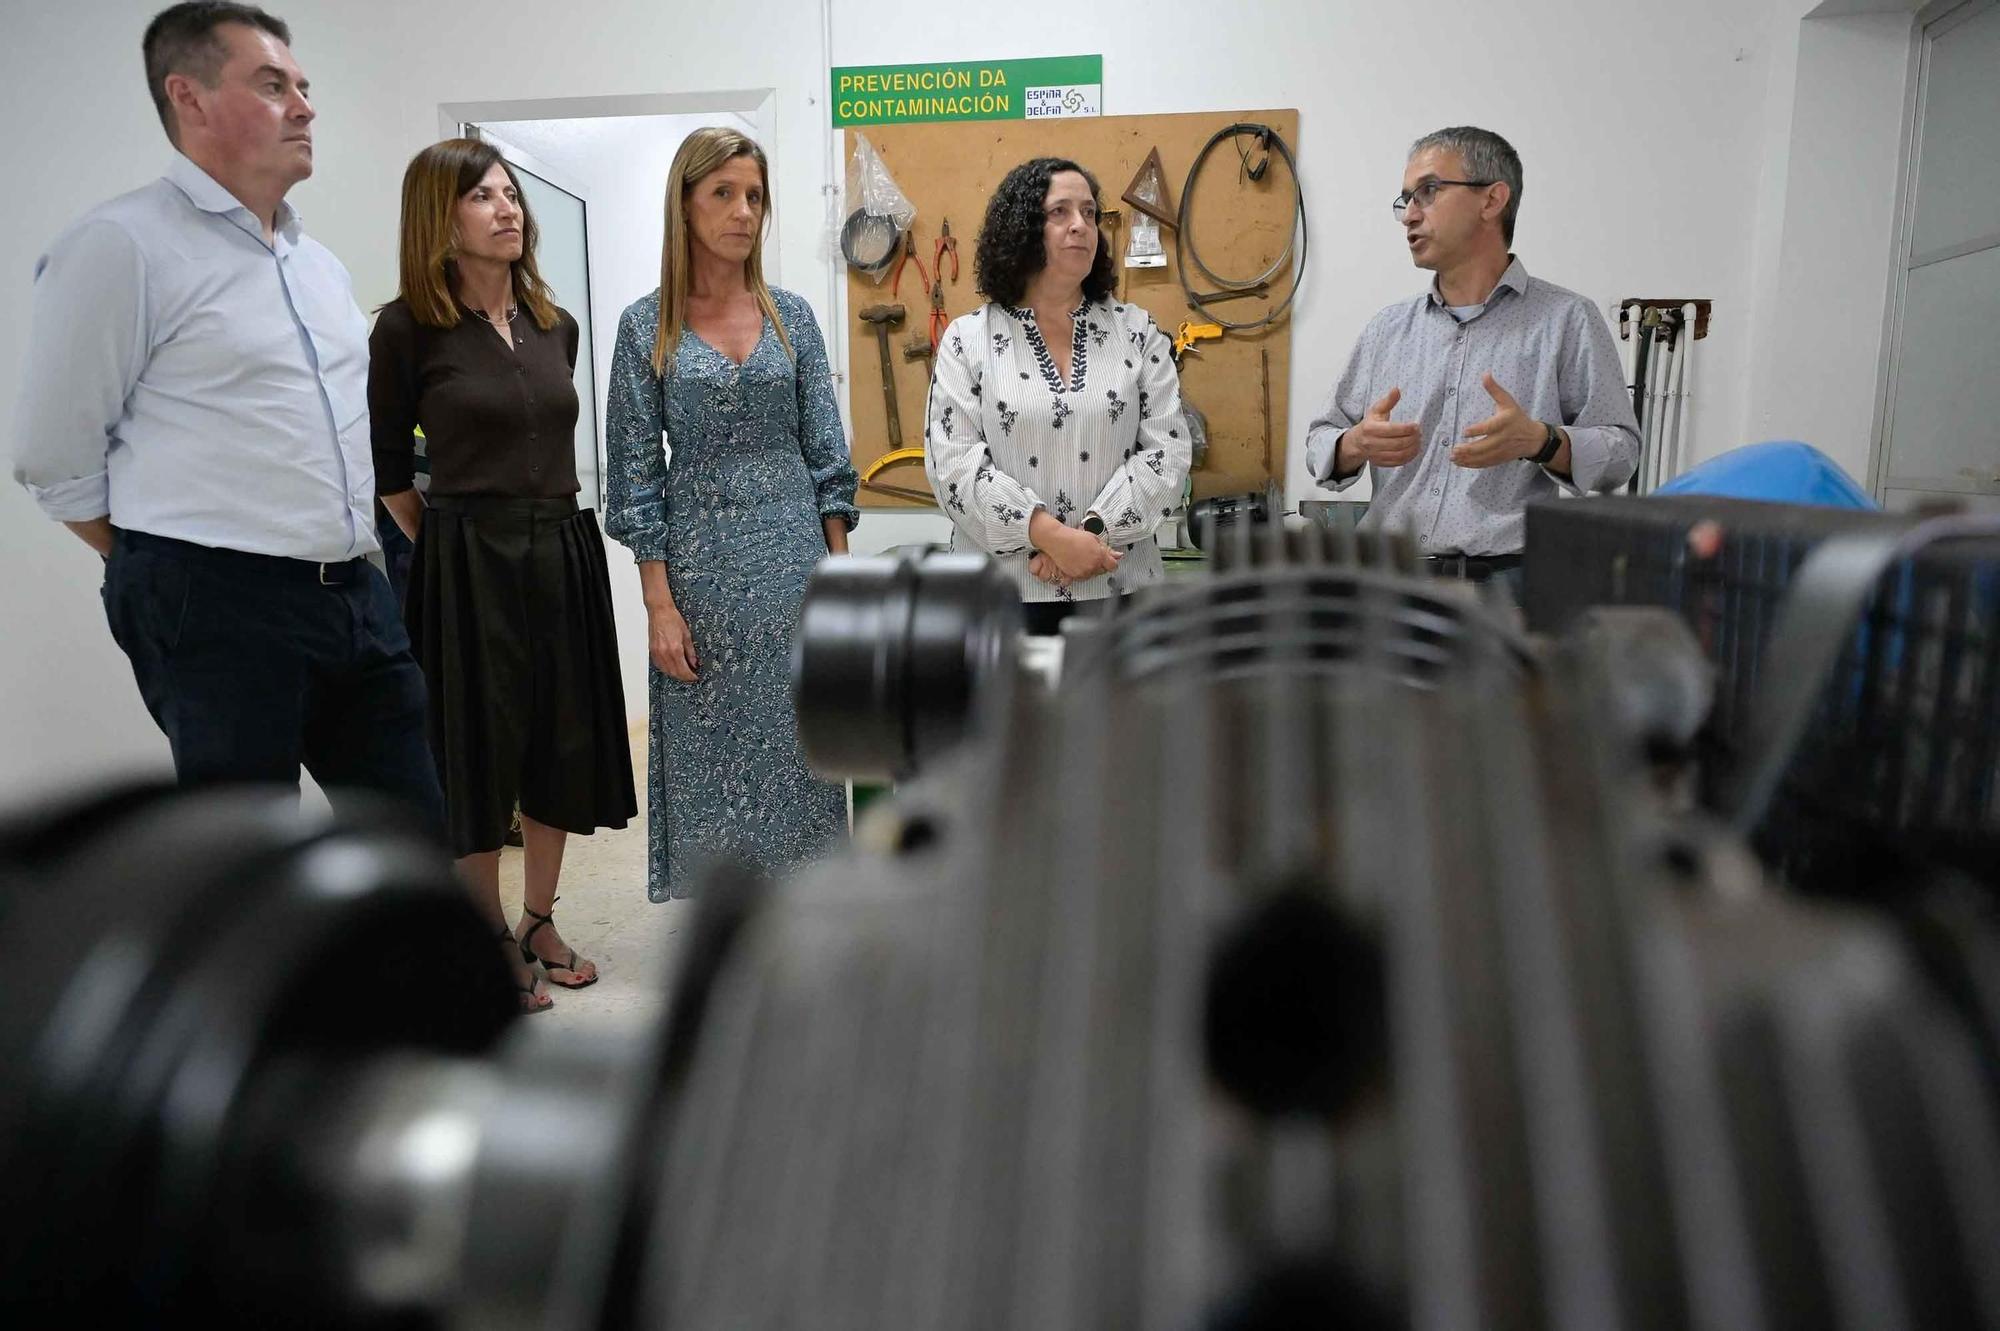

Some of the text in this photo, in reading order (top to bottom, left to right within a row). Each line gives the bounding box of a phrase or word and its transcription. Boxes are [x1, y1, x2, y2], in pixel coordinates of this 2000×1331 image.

[840, 68, 1007, 93] PREVENCIÓN DA
[838, 91, 1009, 118] CONTAMINACIÓN
